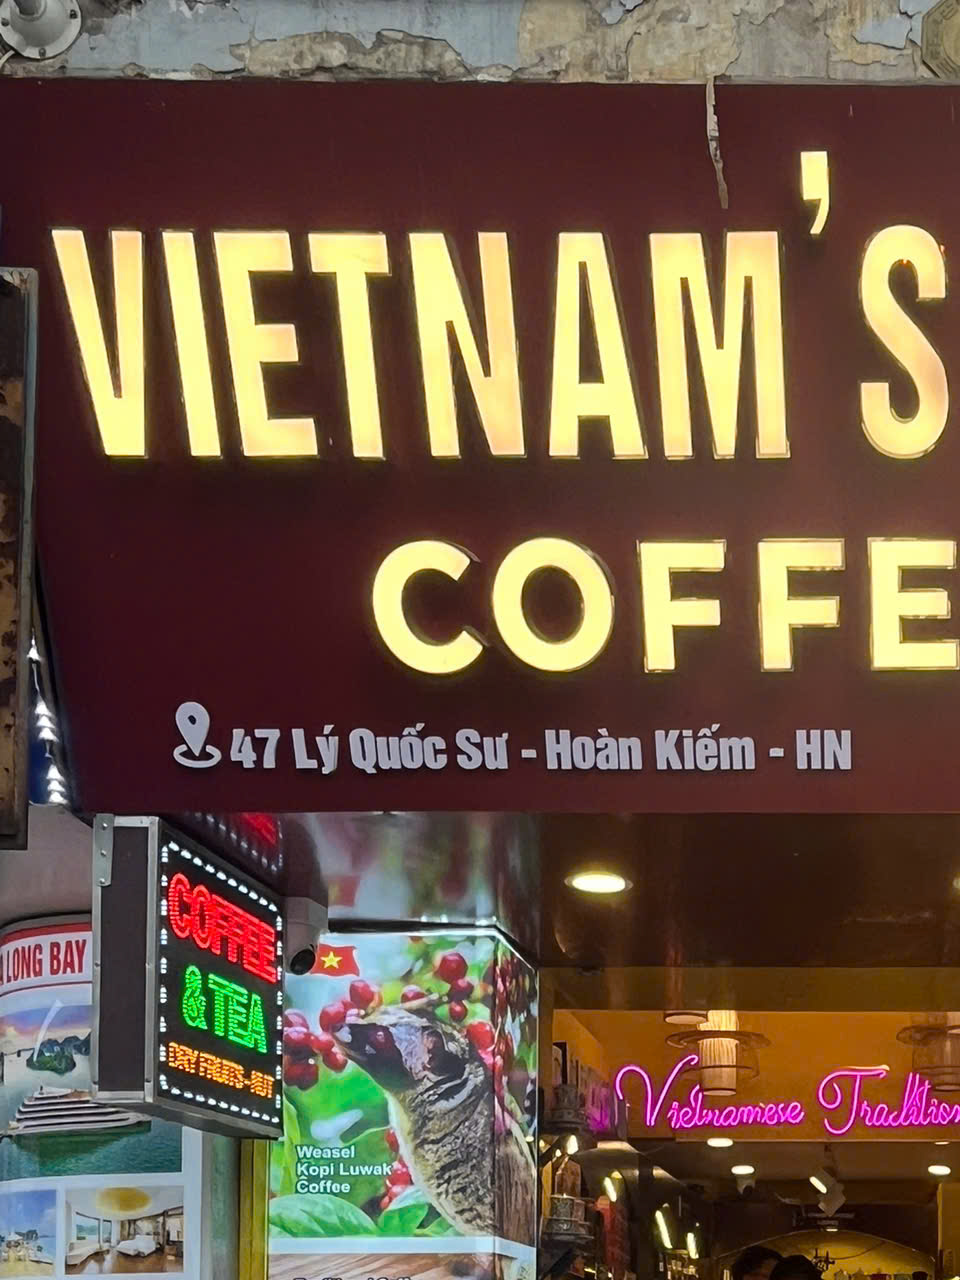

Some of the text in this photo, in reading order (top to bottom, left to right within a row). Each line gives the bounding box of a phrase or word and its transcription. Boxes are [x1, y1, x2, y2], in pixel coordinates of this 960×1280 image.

[51, 150, 950, 460] VIETNAM'S
[230, 722, 852, 775] 47 Lý Quốc Sư - Hoàn Kiếm - HN
[168, 872, 276, 984] COFFEE
[6, 943, 43, 984] LONG
[49, 939, 87, 976] BAY
[182, 964, 268, 1054] & TEA
[614, 1053, 806, 1130] Vietnamese
[296, 1145, 356, 1159] Weasel
[296, 1162, 392, 1178] Kopi Luwak
[296, 1179, 351, 1194] Coffee
